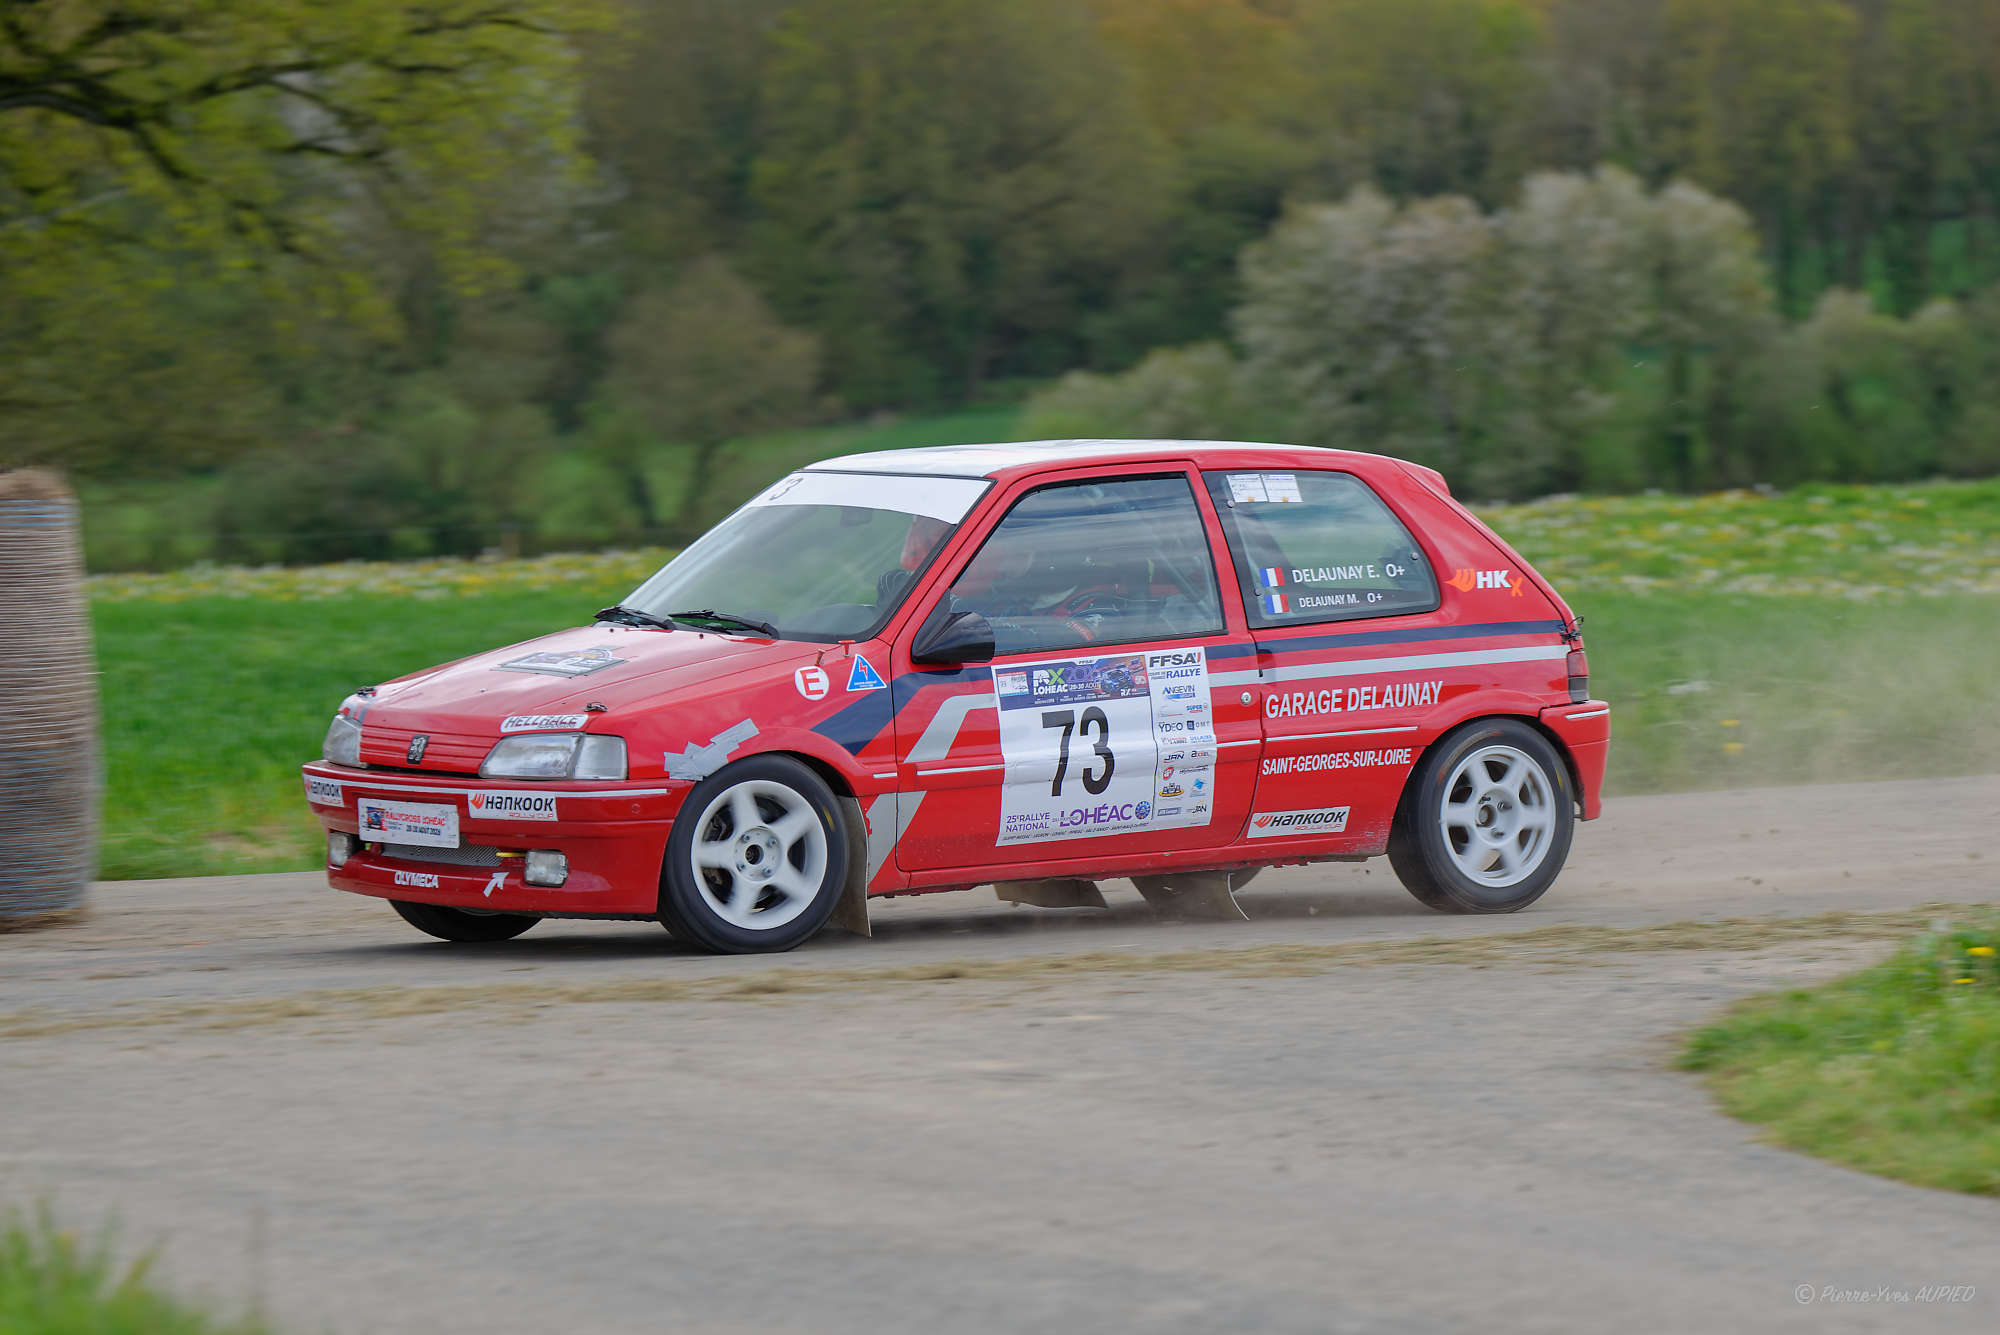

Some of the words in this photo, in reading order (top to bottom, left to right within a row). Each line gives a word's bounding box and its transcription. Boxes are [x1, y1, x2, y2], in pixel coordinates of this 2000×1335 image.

[1291, 565, 1364, 585] DELAUNAY
[1367, 563, 1380, 580] E.
[1298, 594, 1346, 609] DELAUNAY
[1347, 593, 1361, 608] M.
[1149, 653, 1197, 668] FFSA
[799, 667, 824, 696] E
[1166, 668, 1201, 679] RALLYE
[1033, 683, 1068, 696] LOHEAC
[1265, 688, 1343, 719] GARAGE
[1347, 680, 1443, 712] DELAUNAY
[1041, 706, 1114, 797] 73
[1262, 748, 1412, 775] SAINT-GEORGES-SUR-LOIRE
[1020, 812, 1051, 823] RALLYE
[1060, 803, 1133, 827] LOHÉAC
[1005, 821, 1049, 833] NATIONAL
[394, 870, 439, 889] OLYMECA
